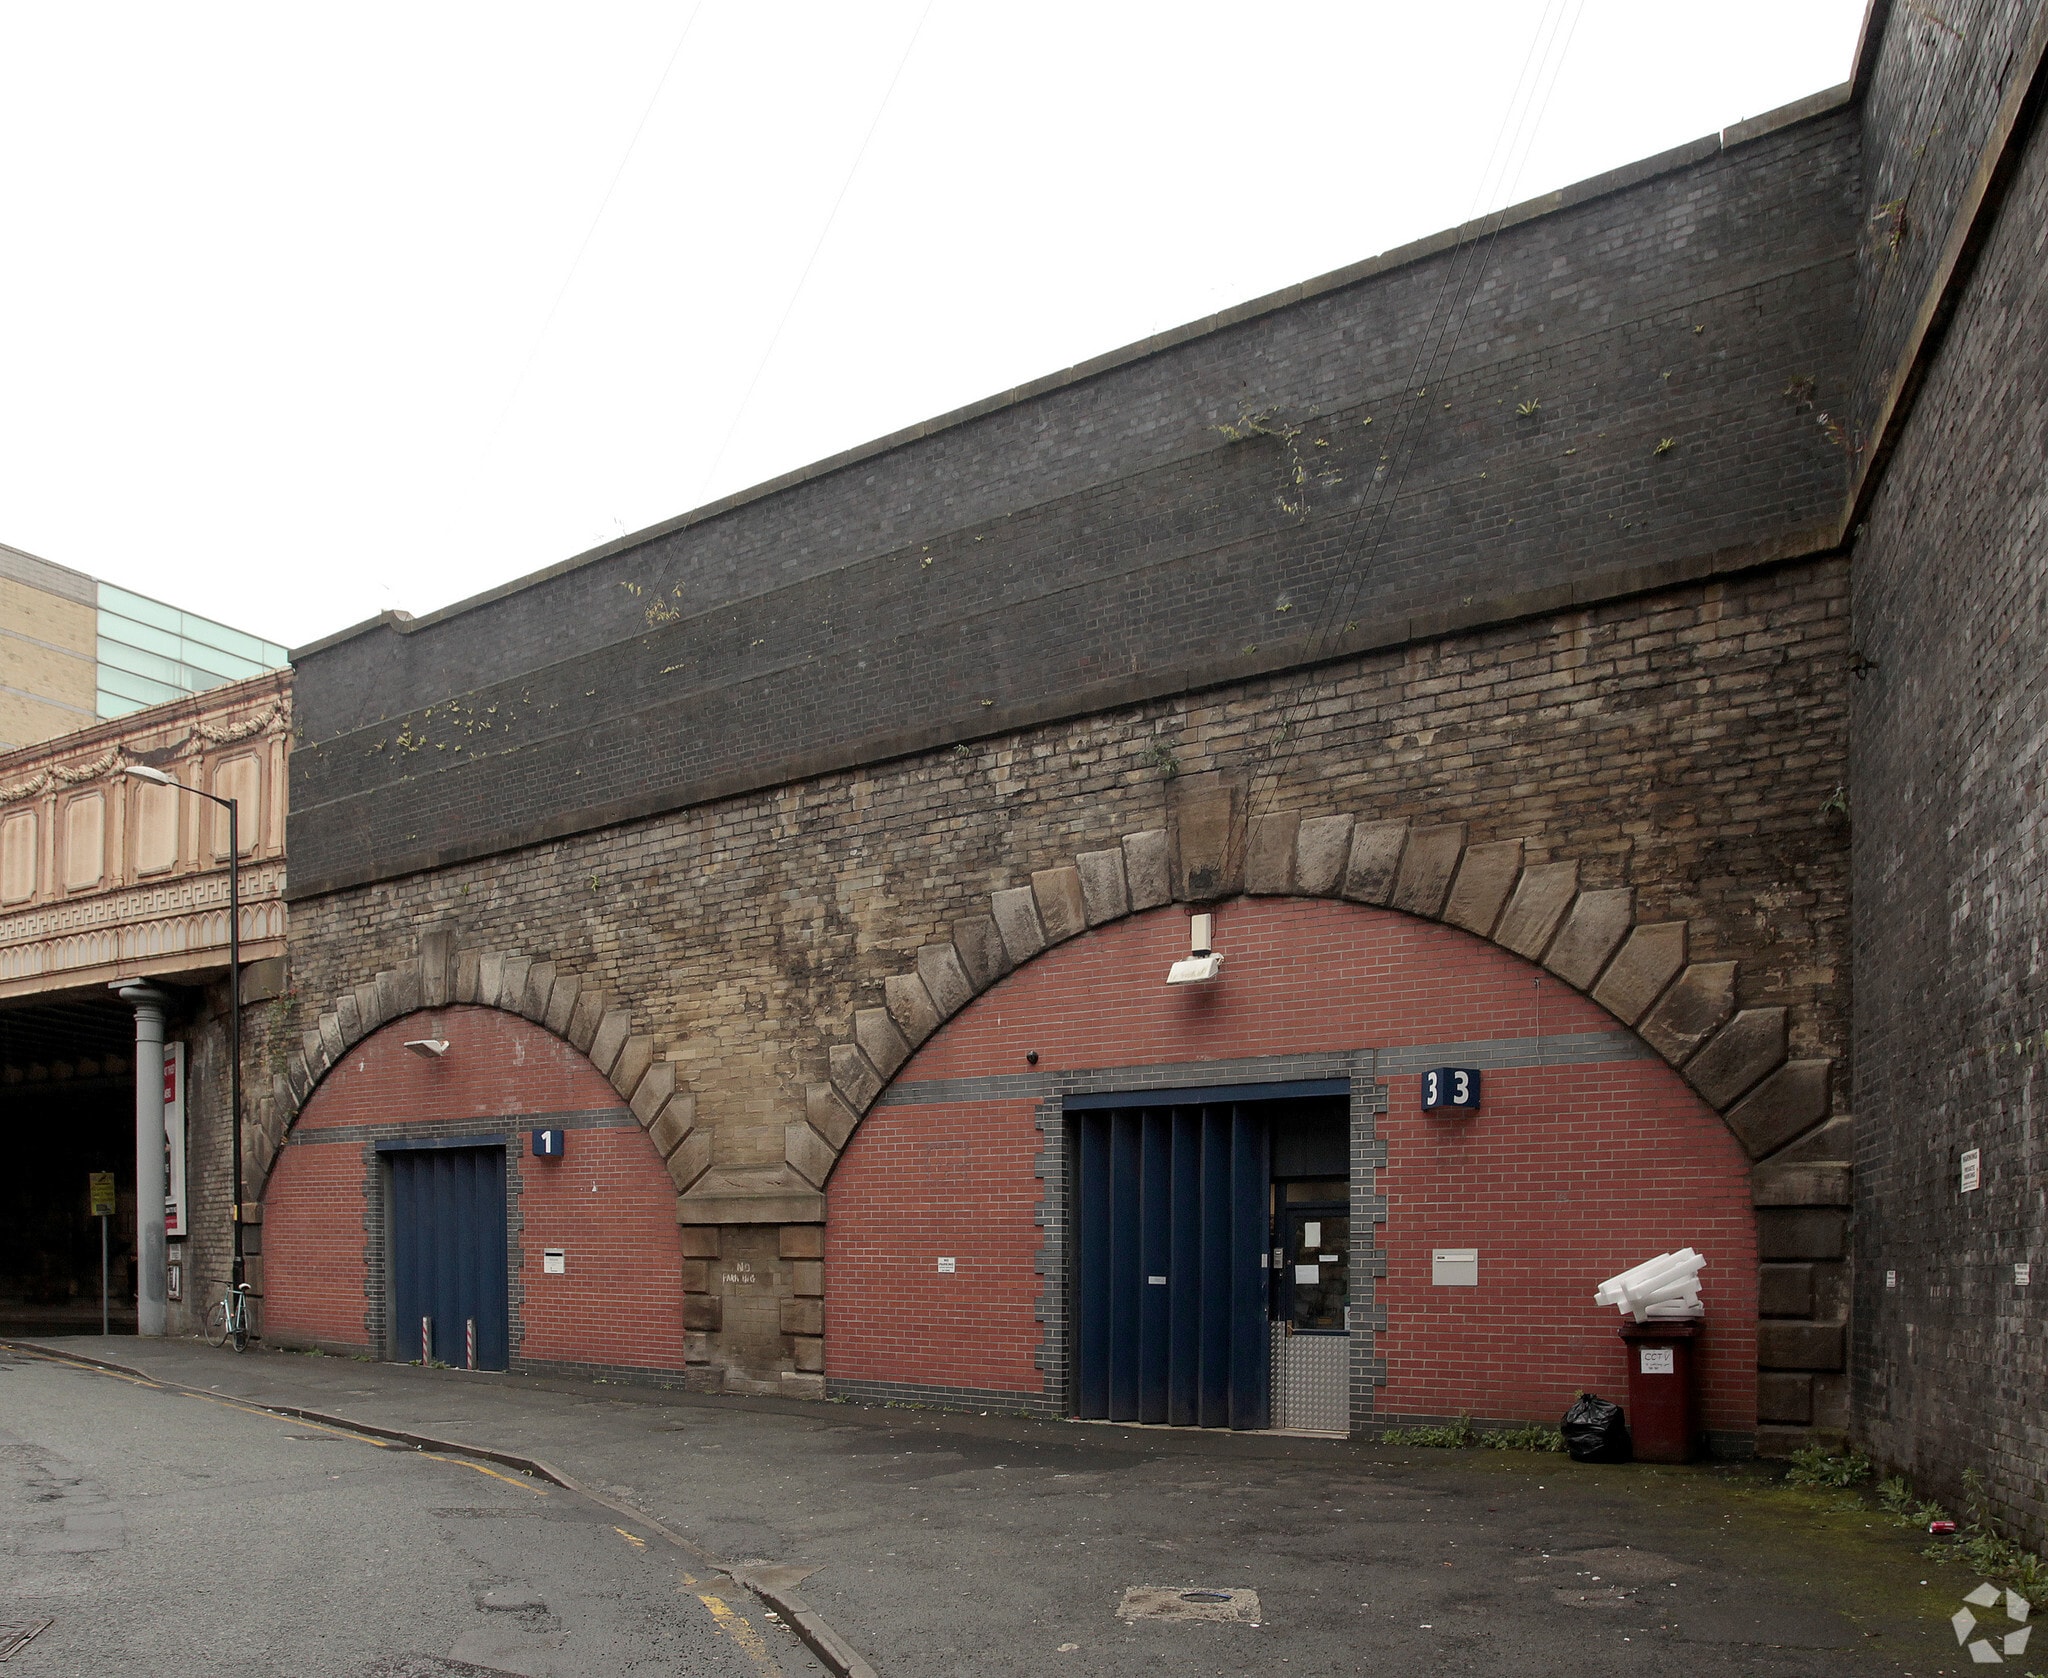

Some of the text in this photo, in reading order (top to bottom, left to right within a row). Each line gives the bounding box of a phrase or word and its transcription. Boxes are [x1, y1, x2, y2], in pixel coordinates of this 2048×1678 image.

[1427, 1071, 1438, 1105] 3
[1453, 1070, 1469, 1104] 3
[541, 1130, 551, 1154] 1
[736, 1262, 751, 1272] NO
[1644, 1351, 1670, 1361] CCTV
